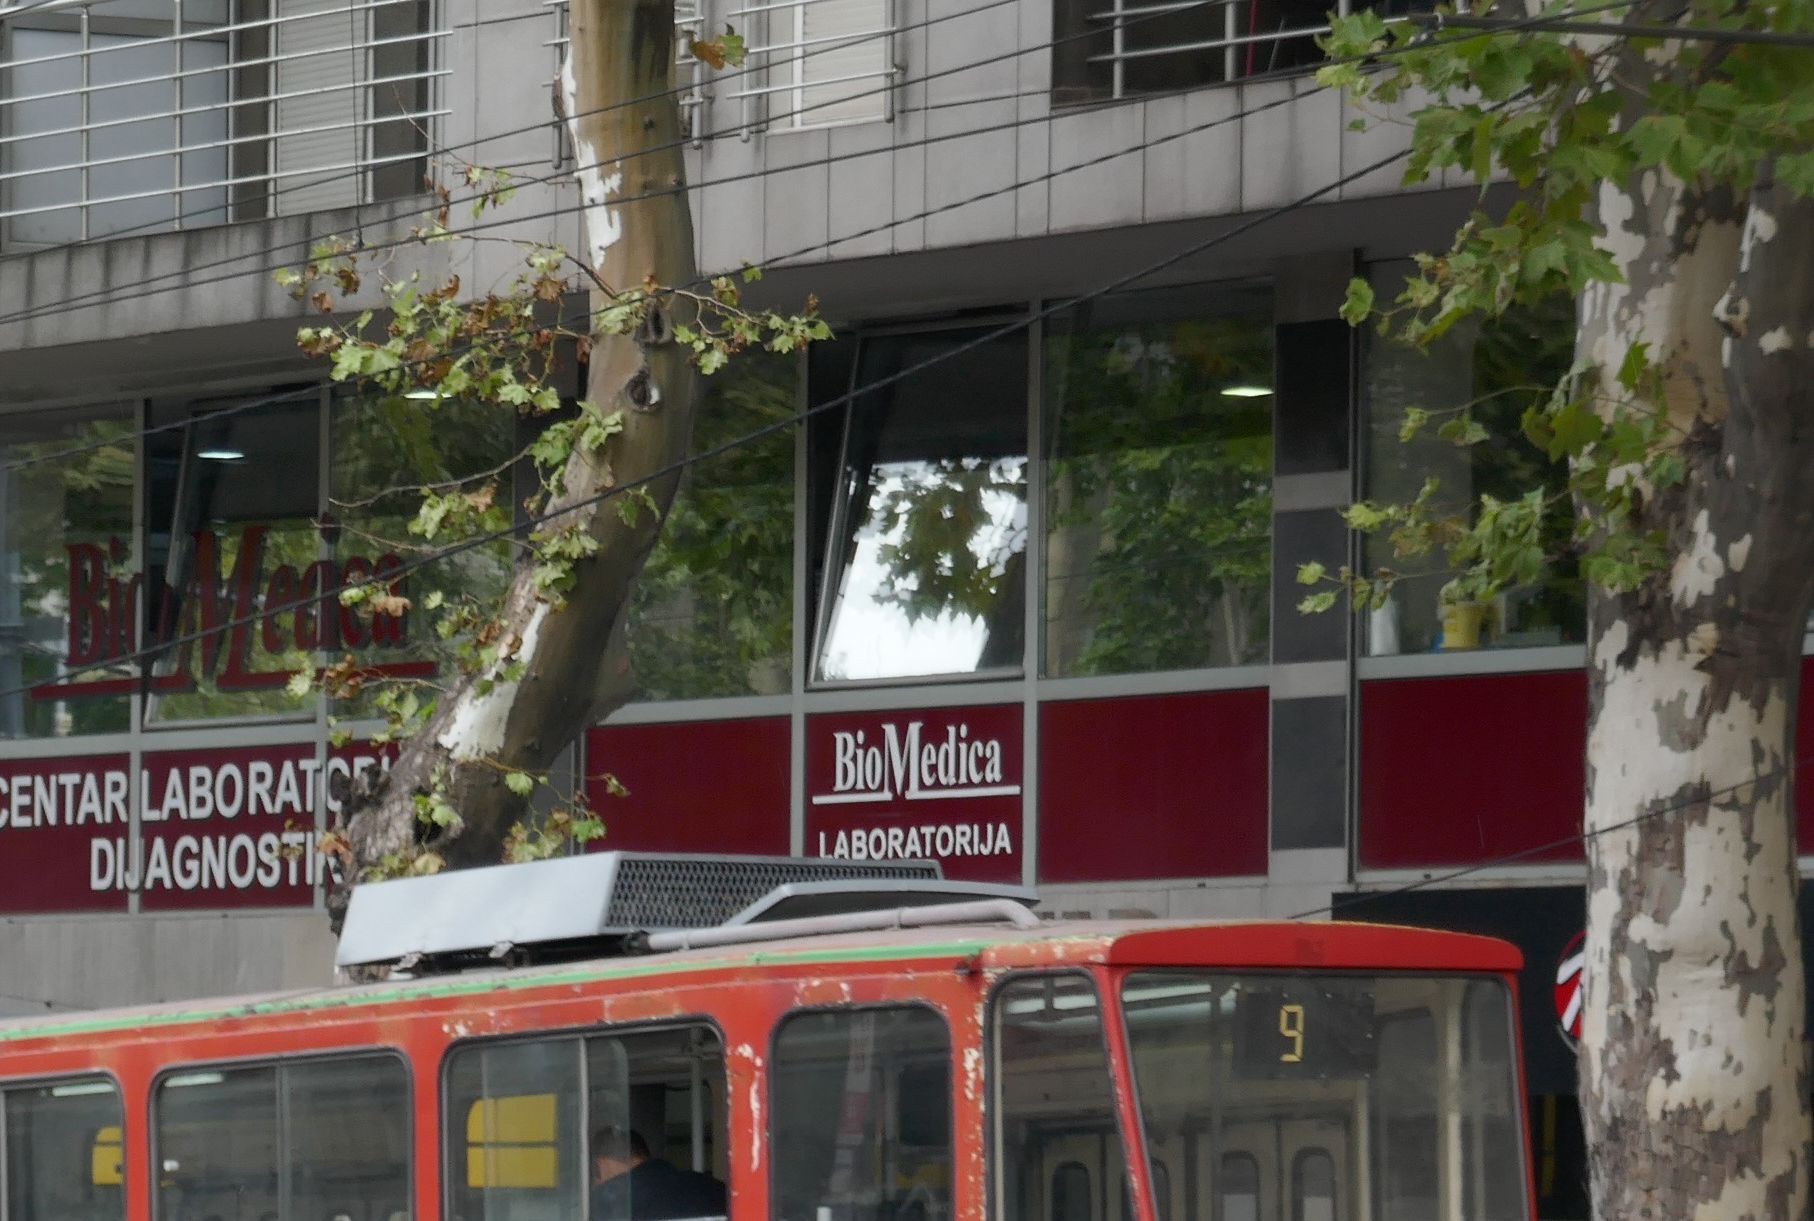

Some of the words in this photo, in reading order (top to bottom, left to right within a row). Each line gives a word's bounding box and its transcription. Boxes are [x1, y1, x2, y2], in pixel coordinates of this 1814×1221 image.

[141, 755, 391, 822] LABORATO
[833, 721, 1003, 799] BioMedica
[90, 831, 345, 891] DIJAGNOSTIK
[819, 823, 1013, 860] LABORATORIJA
[1280, 1005, 1305, 1062] 9
